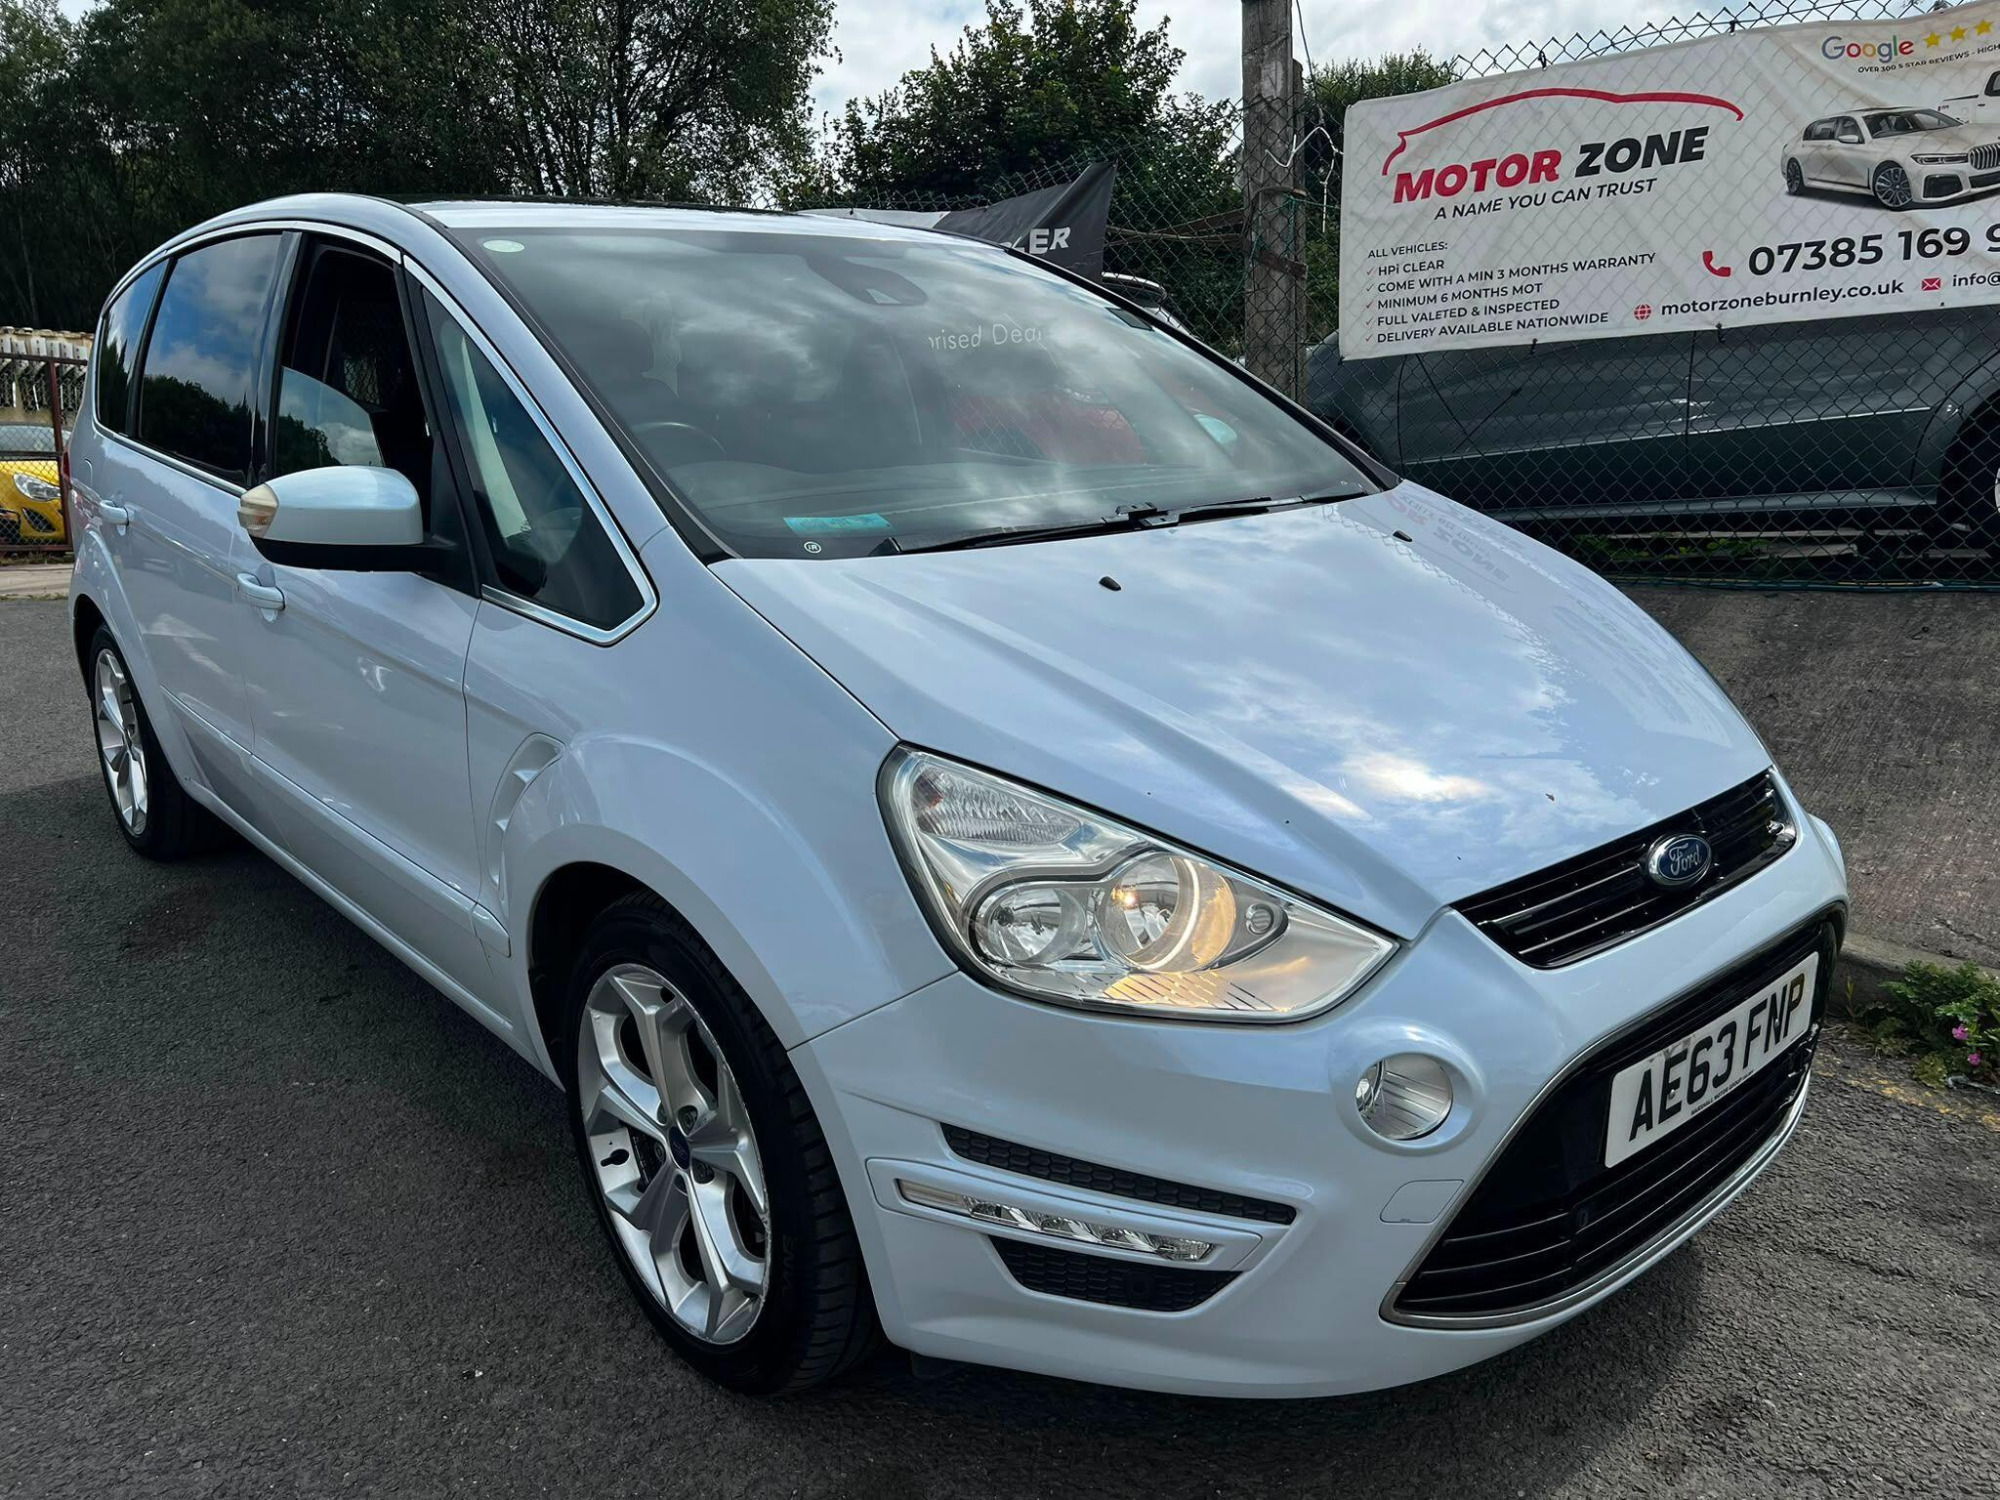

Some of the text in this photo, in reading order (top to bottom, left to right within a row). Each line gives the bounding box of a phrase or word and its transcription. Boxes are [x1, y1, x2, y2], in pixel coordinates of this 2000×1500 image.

[1822, 35, 1914, 63] Google
[1881, 64, 1896, 72] 300
[1905, 59, 1927, 68] STAR
[1929, 51, 1970, 64] REVIEWS
[1393, 125, 1709, 203] MOTOR ZONE
[1434, 178, 1657, 220] A NAME YOU CAN TRUST
[1368, 241, 1448, 258] ALL VEHICLES:
[1749, 234, 1884, 276] 07385
[1898, 227, 1971, 261] 169
[1377, 252, 1656, 293] COME WITH A MIN 3 MONTHS WARRANTY
[1378, 260, 1444, 276] HPi CLEAR
[1378, 283, 1543, 309] MINIMUM 6 MONTHS MOT
[1661, 279, 1904, 316] motorzoneburnley.co.uk
[1377, 299, 1560, 326] FULL VALETED & INSPECTED
[1377, 312, 1609, 343] DELIVERY AVAILABLE NATIONWIDE
[992, 323, 1041, 345] Dea
[1669, 842, 1702, 876] Ford
[1629, 973, 1805, 1142] AE63 FNP
